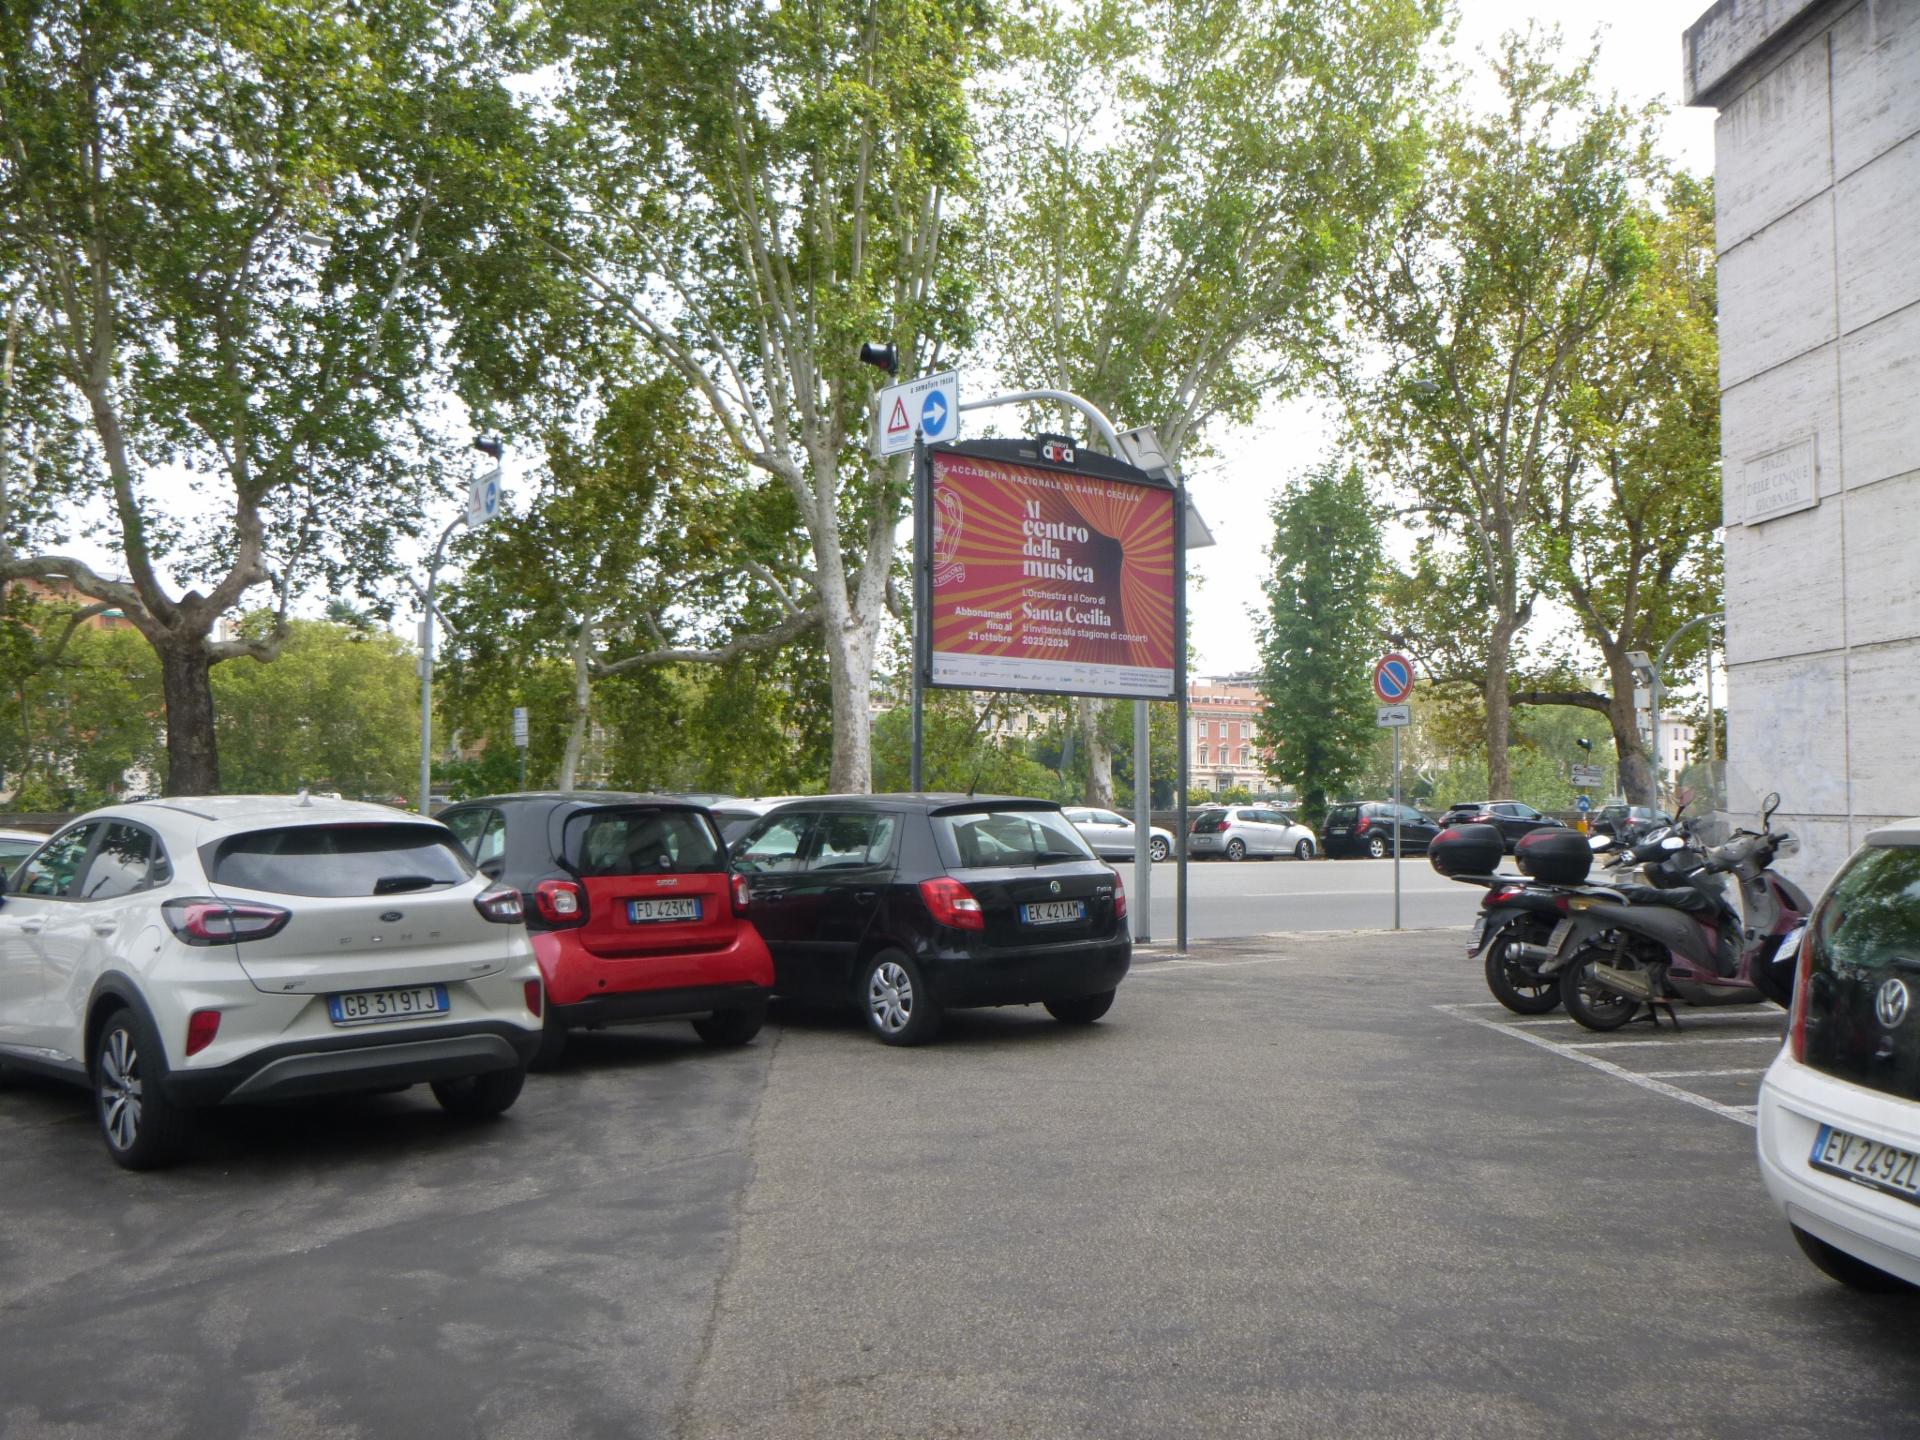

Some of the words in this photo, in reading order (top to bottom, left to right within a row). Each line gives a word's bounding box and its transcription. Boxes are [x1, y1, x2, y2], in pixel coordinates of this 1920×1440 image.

[1043, 445, 1074, 464] apa
[951, 465, 1007, 481] ACCADEMIA
[1010, 475, 1061, 490] NAZIONALE
[1064, 481, 1074, 491] DI
[1076, 484, 1104, 496] SANTA
[1106, 490, 1140, 502] CECILIA
[1022, 500, 1040, 519] Al
[1022, 518, 1089, 543] centro
[1022, 537, 1061, 560] della
[1022, 558, 1095, 584] musica
[1022, 588, 1066, 601] L'Orchestra
[1073, 593, 1079, 602] il
[1079, 594, 1097, 605] Coro
[1098, 596, 1106, 605] di
[955, 606, 1013, 620] Abbonamenti
[1022, 602, 1063, 622] Santa
[1065, 606, 1111, 626] Cecilia
[986, 619, 1004, 631] fino
[1004, 622, 1013, 632] al
[1029, 624, 1062, 635] invitano
[1062, 626, 1076, 636] alla
[1077, 628, 1109, 641] stagione
[1110, 631, 1118, 640] di
[1118, 633, 1148, 643] concerti
[968, 631, 978, 641] 21
[979, 632, 1012, 644] ottobre
[1022, 635, 1069, 648] 2023/2024
[636, 902, 653, 918] FD
[657, 899, 694, 917] 423KM
[1028, 904, 1043, 920] EK
[344, 995, 369, 1017] GB
[376, 988, 435, 1013] 319TJ
[1824, 1131, 1852, 1165] EV
[1854, 1140, 1917, 1190] 249ZL
